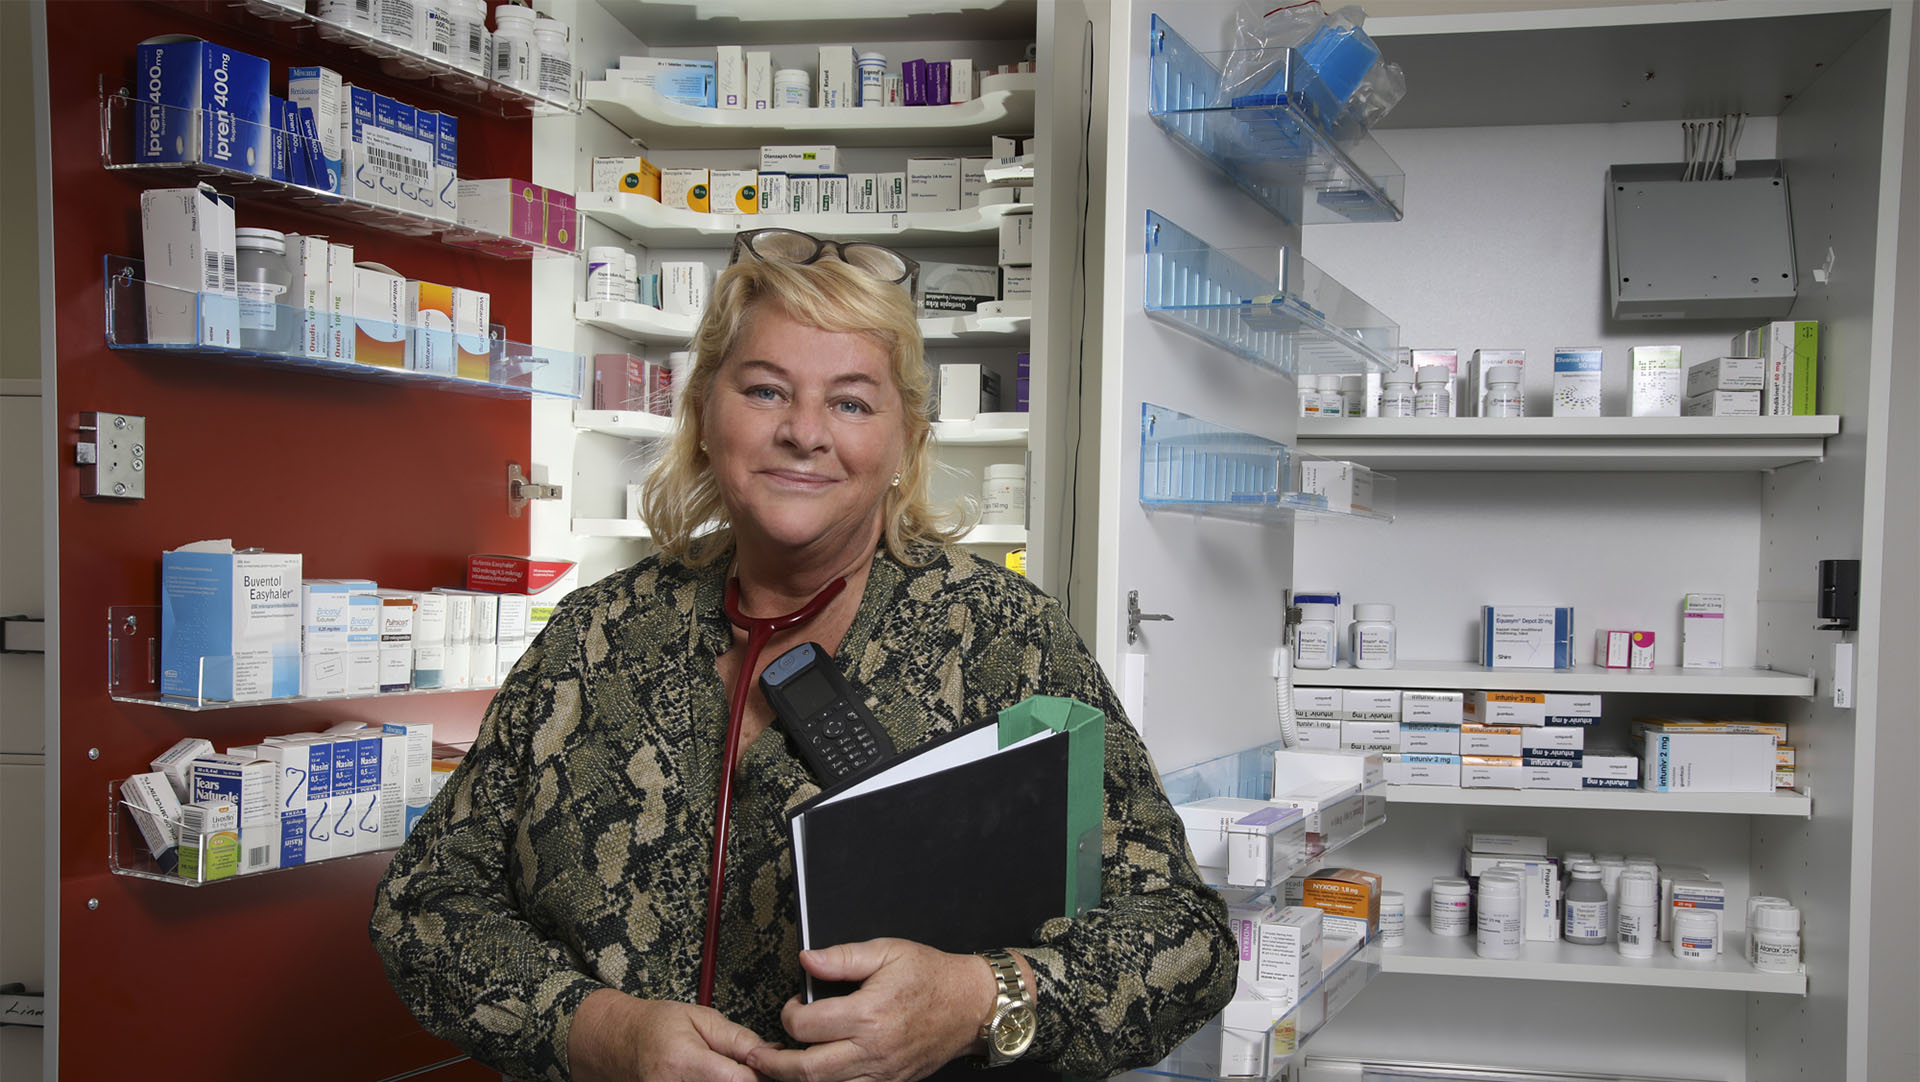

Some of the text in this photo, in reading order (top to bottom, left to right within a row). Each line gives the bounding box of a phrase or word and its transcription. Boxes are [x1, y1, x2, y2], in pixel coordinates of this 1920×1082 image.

[354, 106, 371, 118] Nasin
[379, 113, 395, 125] Nasin
[148, 106, 162, 157] Ipren
[214, 110, 232, 161] Ipren
[440, 131, 456, 143] Nasin
[309, 290, 316, 304] mg
[334, 296, 341, 310] mg
[243, 575, 282, 588] Buventol
[250, 588, 291, 602] Easyhaler
[1571, 717, 1592, 725] intuniv
[1661, 736, 1670, 750] mg
[1551, 750, 1575, 758] intuniv
[336, 759, 354, 769] Nasin
[360, 756, 378, 765] Nasin
[311, 763, 329, 772] Nasin
[1659, 761, 1668, 787] intuniv
[195, 777, 220, 791] Tears
[195, 789, 238, 803] Naturale
[284, 838, 304, 848] Nasin
[1313, 883, 1340, 891] NYXOID
